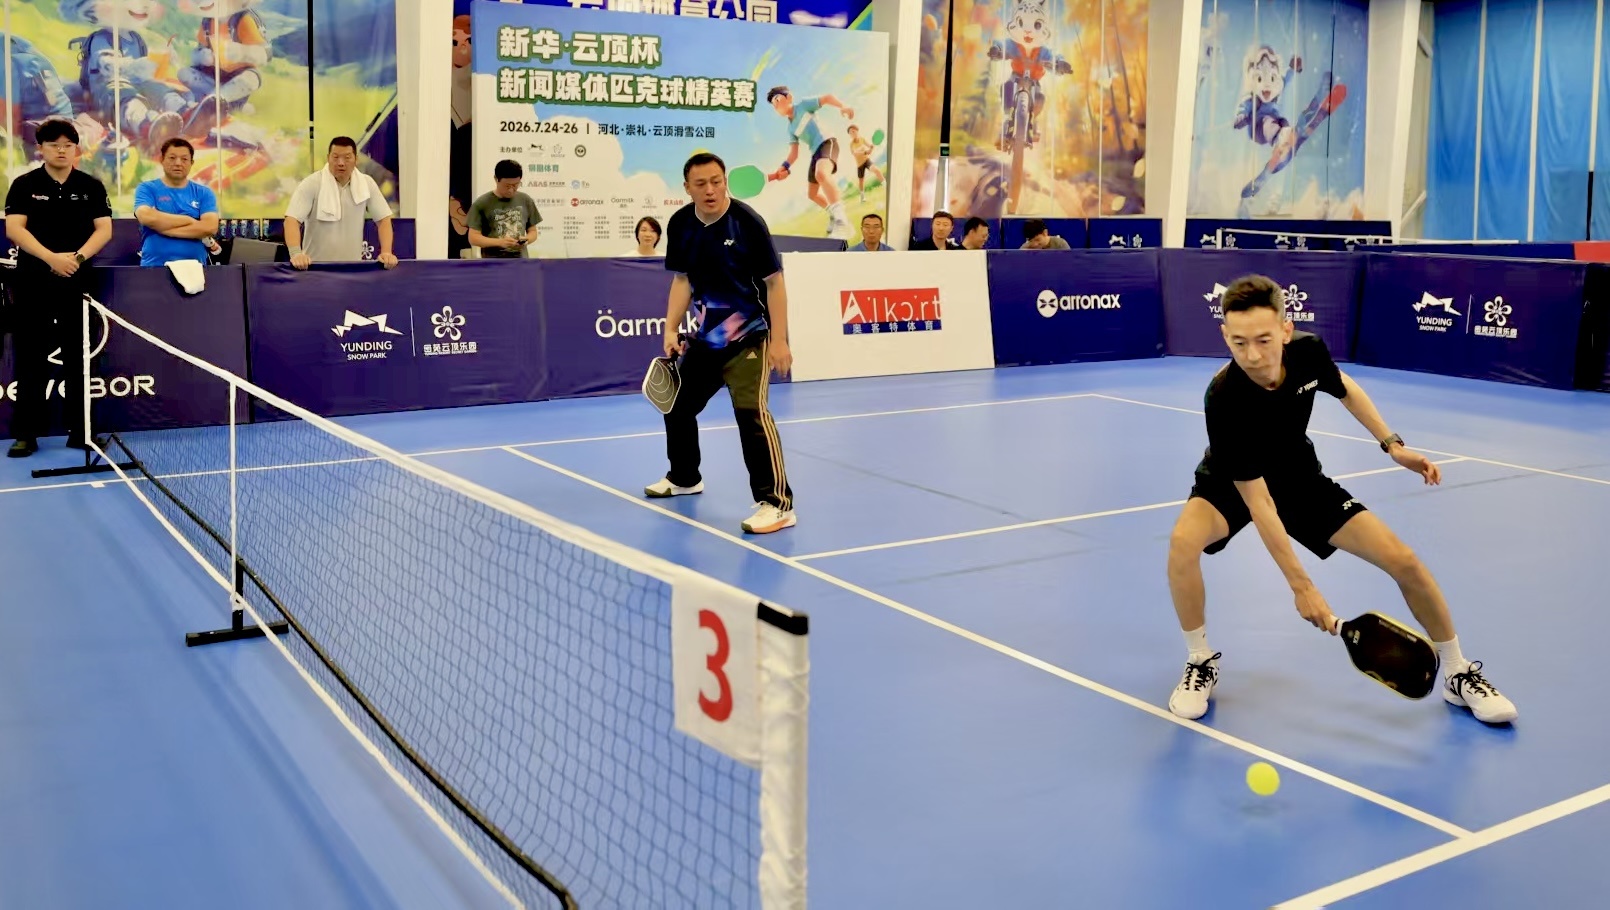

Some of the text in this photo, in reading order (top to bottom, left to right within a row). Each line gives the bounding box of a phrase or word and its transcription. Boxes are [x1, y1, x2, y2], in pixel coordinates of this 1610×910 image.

[499, 26, 659, 66] 新华·云顶杯
[499, 67, 755, 110] 新闻媒体匹克球精英赛
[500, 121, 715, 139] 2026.7.24-26 河北·崇礼·云顶滑雪公园
[1060, 294, 1121, 311] arronax
[852, 321, 934, 334] 奥客特体育
[1416, 316, 1453, 327] YUNDING
[340, 340, 393, 352] YUNDING
[347, 353, 368, 361] SNOW
[698, 608, 733, 722] 3
